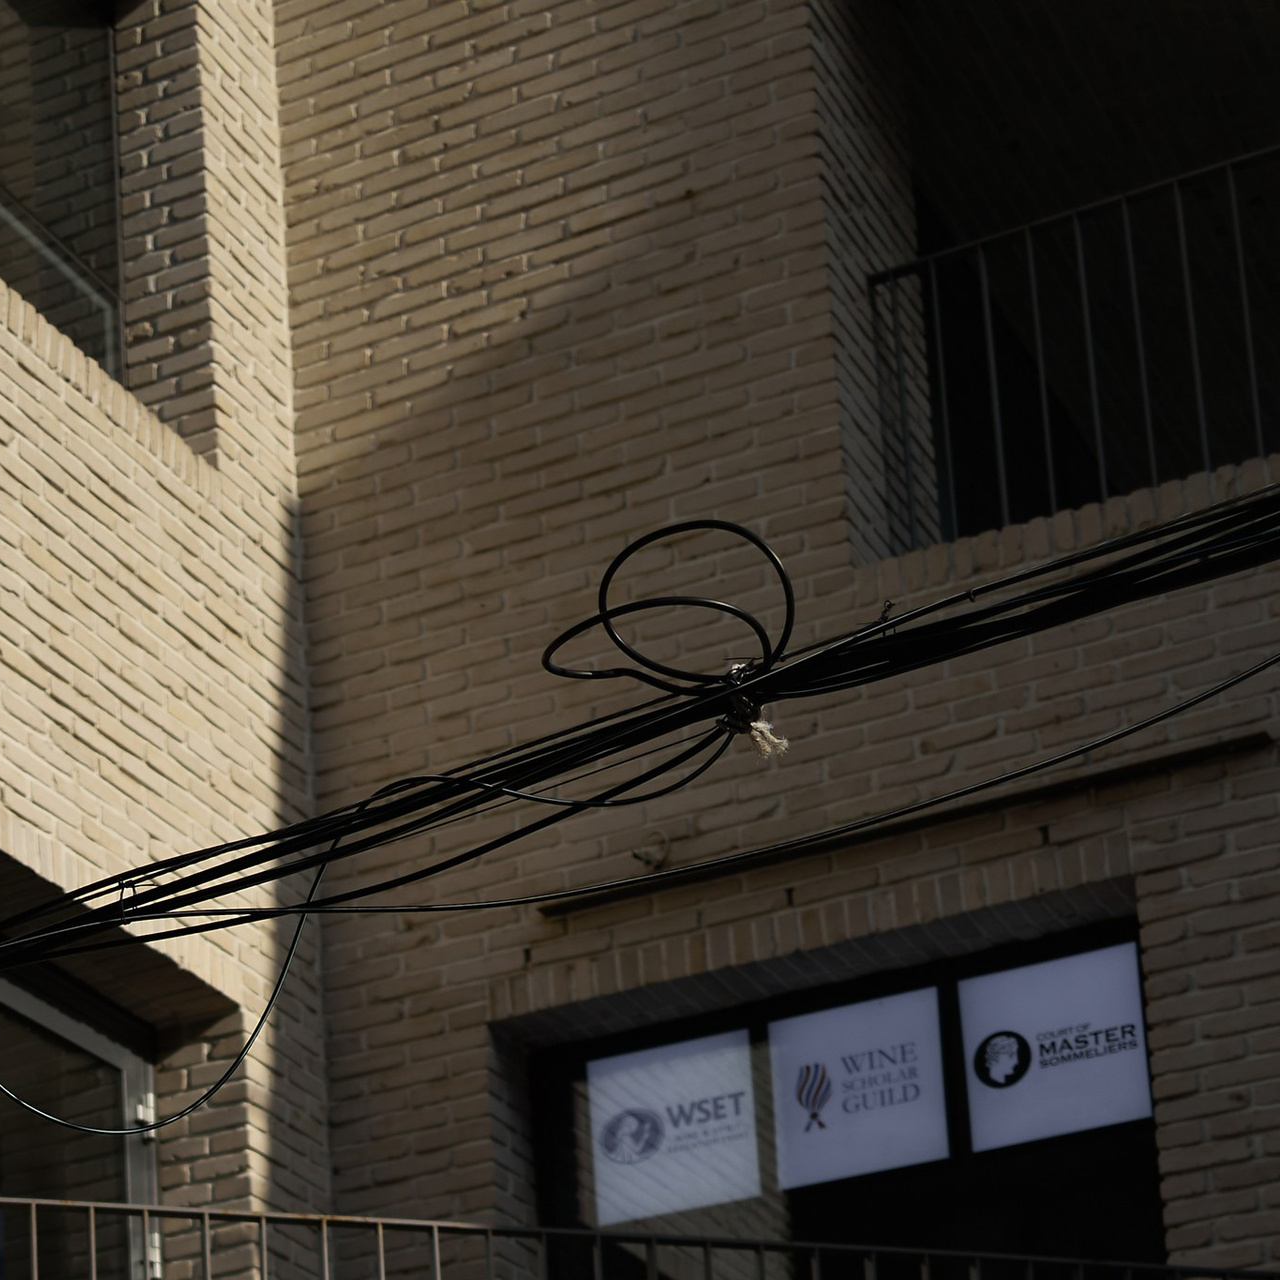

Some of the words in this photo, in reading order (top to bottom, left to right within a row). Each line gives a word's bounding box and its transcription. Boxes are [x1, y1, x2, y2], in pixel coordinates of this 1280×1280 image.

[1039, 1024, 1135, 1057] MASTER
[1039, 1040, 1138, 1069] SOMMELIERS
[841, 1041, 918, 1074] WINE
[841, 1067, 918, 1093] SCHOLAR
[666, 1091, 746, 1129] WSET
[841, 1083, 921, 1114] GUILD
